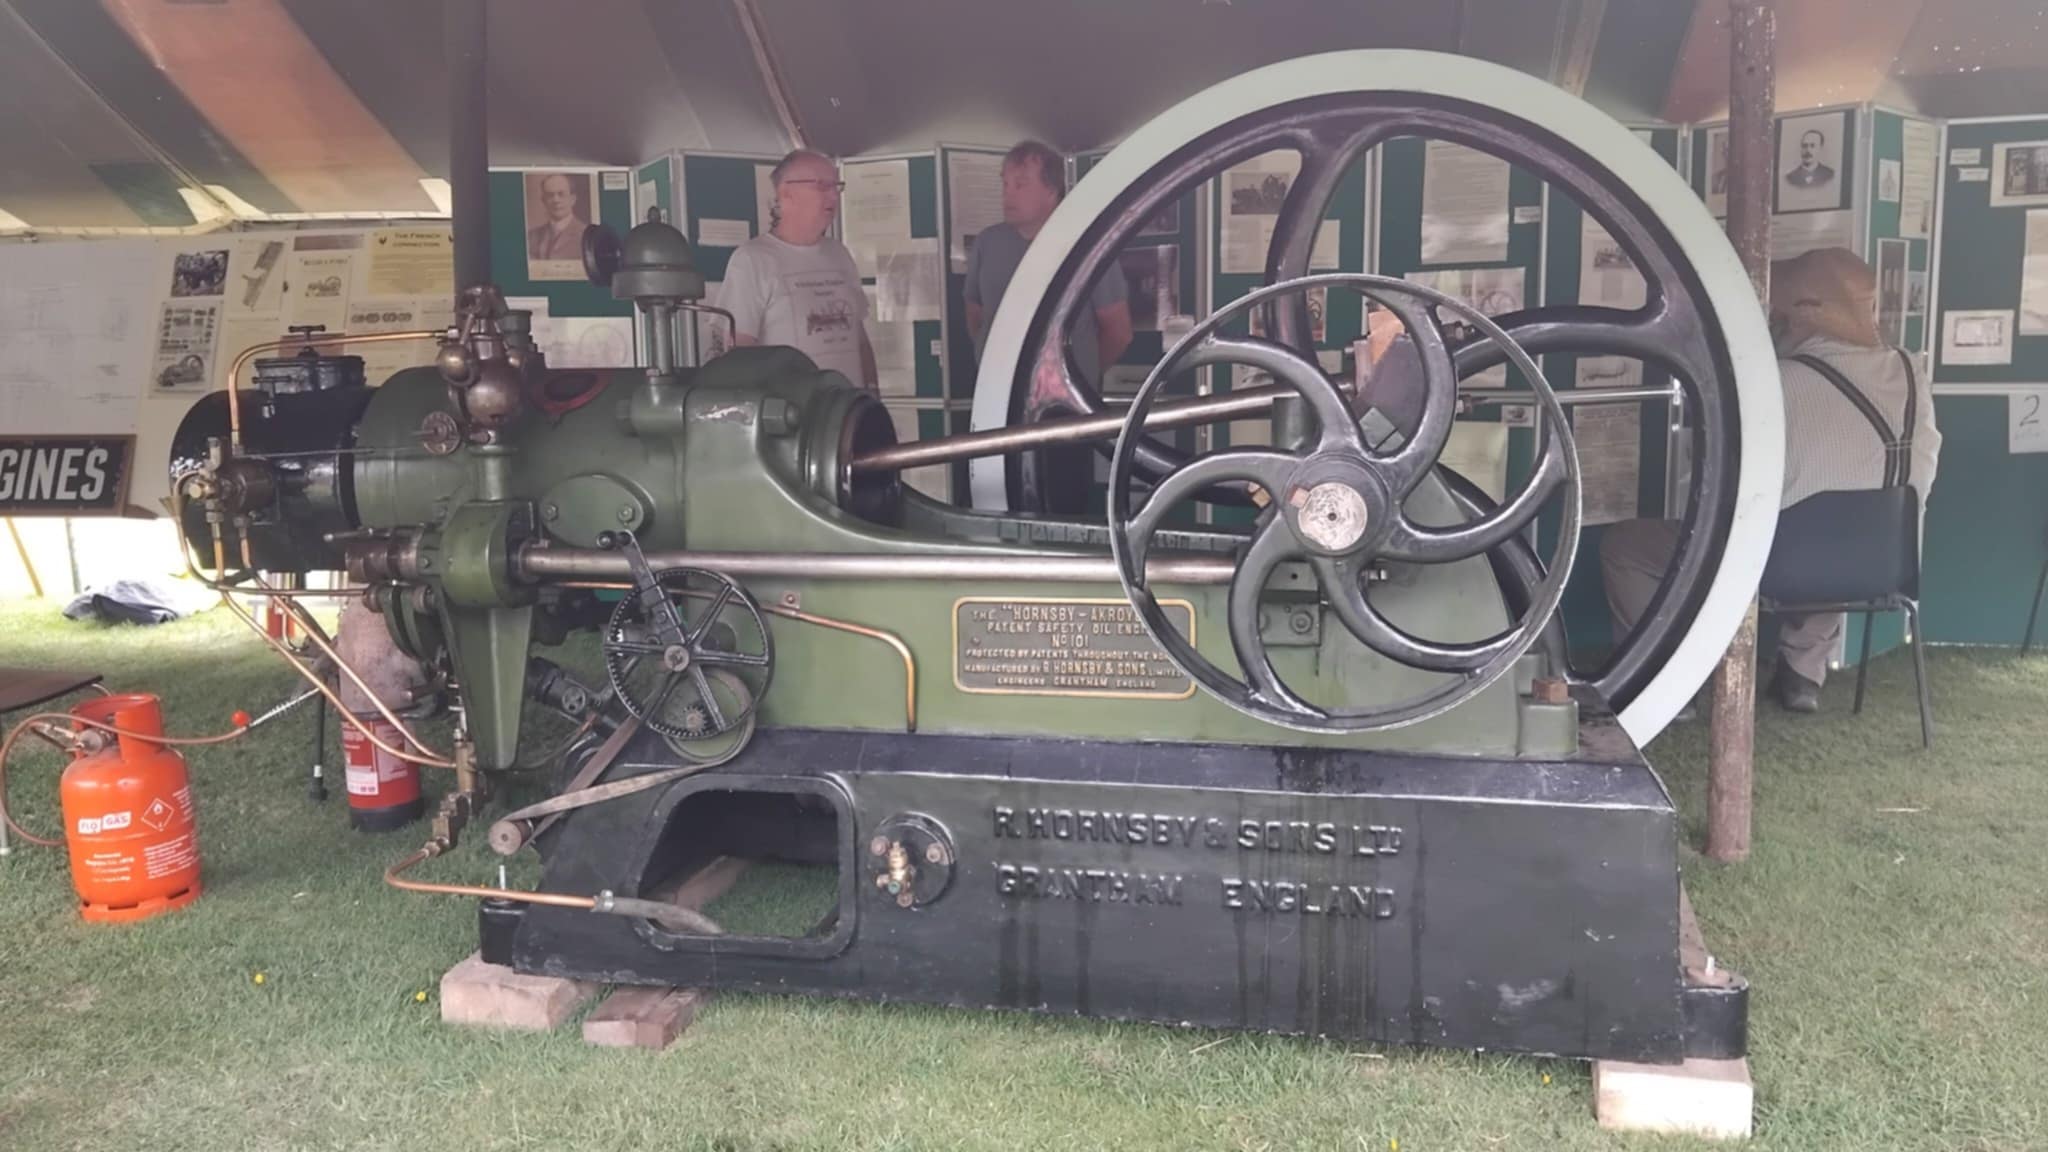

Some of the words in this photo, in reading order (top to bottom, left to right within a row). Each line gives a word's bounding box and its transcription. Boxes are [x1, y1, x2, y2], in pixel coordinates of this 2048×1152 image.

[2019, 394, 2040, 427] 2
[973, 609, 995, 620] THE
[1091, 607, 1141, 622] AKROY
[987, 621, 1032, 633] PATENT
[1038, 622, 1083, 634] SAFETY
[1092, 623, 1111, 634] OIL
[1117, 623, 1147, 635] ENGI
[966, 648, 1016, 658] PROTECTED
[1031, 649, 1068, 659] PATENTS
[1072, 649, 1129, 660] THROUGHOUT
[964, 663, 1028, 673] MANUFACTURED
[1053, 660, 1101, 674] HORNSBY
[1105, 661, 1113, 675] &
[1117, 662, 1146, 676] SONS
[1053, 676, 1108, 687] GRANTHAM
[1116, 679, 1156, 689] ENGLAND
[105, 815, 128, 826] GAS
[1027, 808, 1198, 846] HORNSBY
[1204, 817, 1227, 848] &
[1237, 819, 1336, 852] SONS
[1352, 825, 1403, 856] LTD
[996, 863, 1183, 906] GRANTHAM
[1221, 877, 1396, 917] ENGLAND
